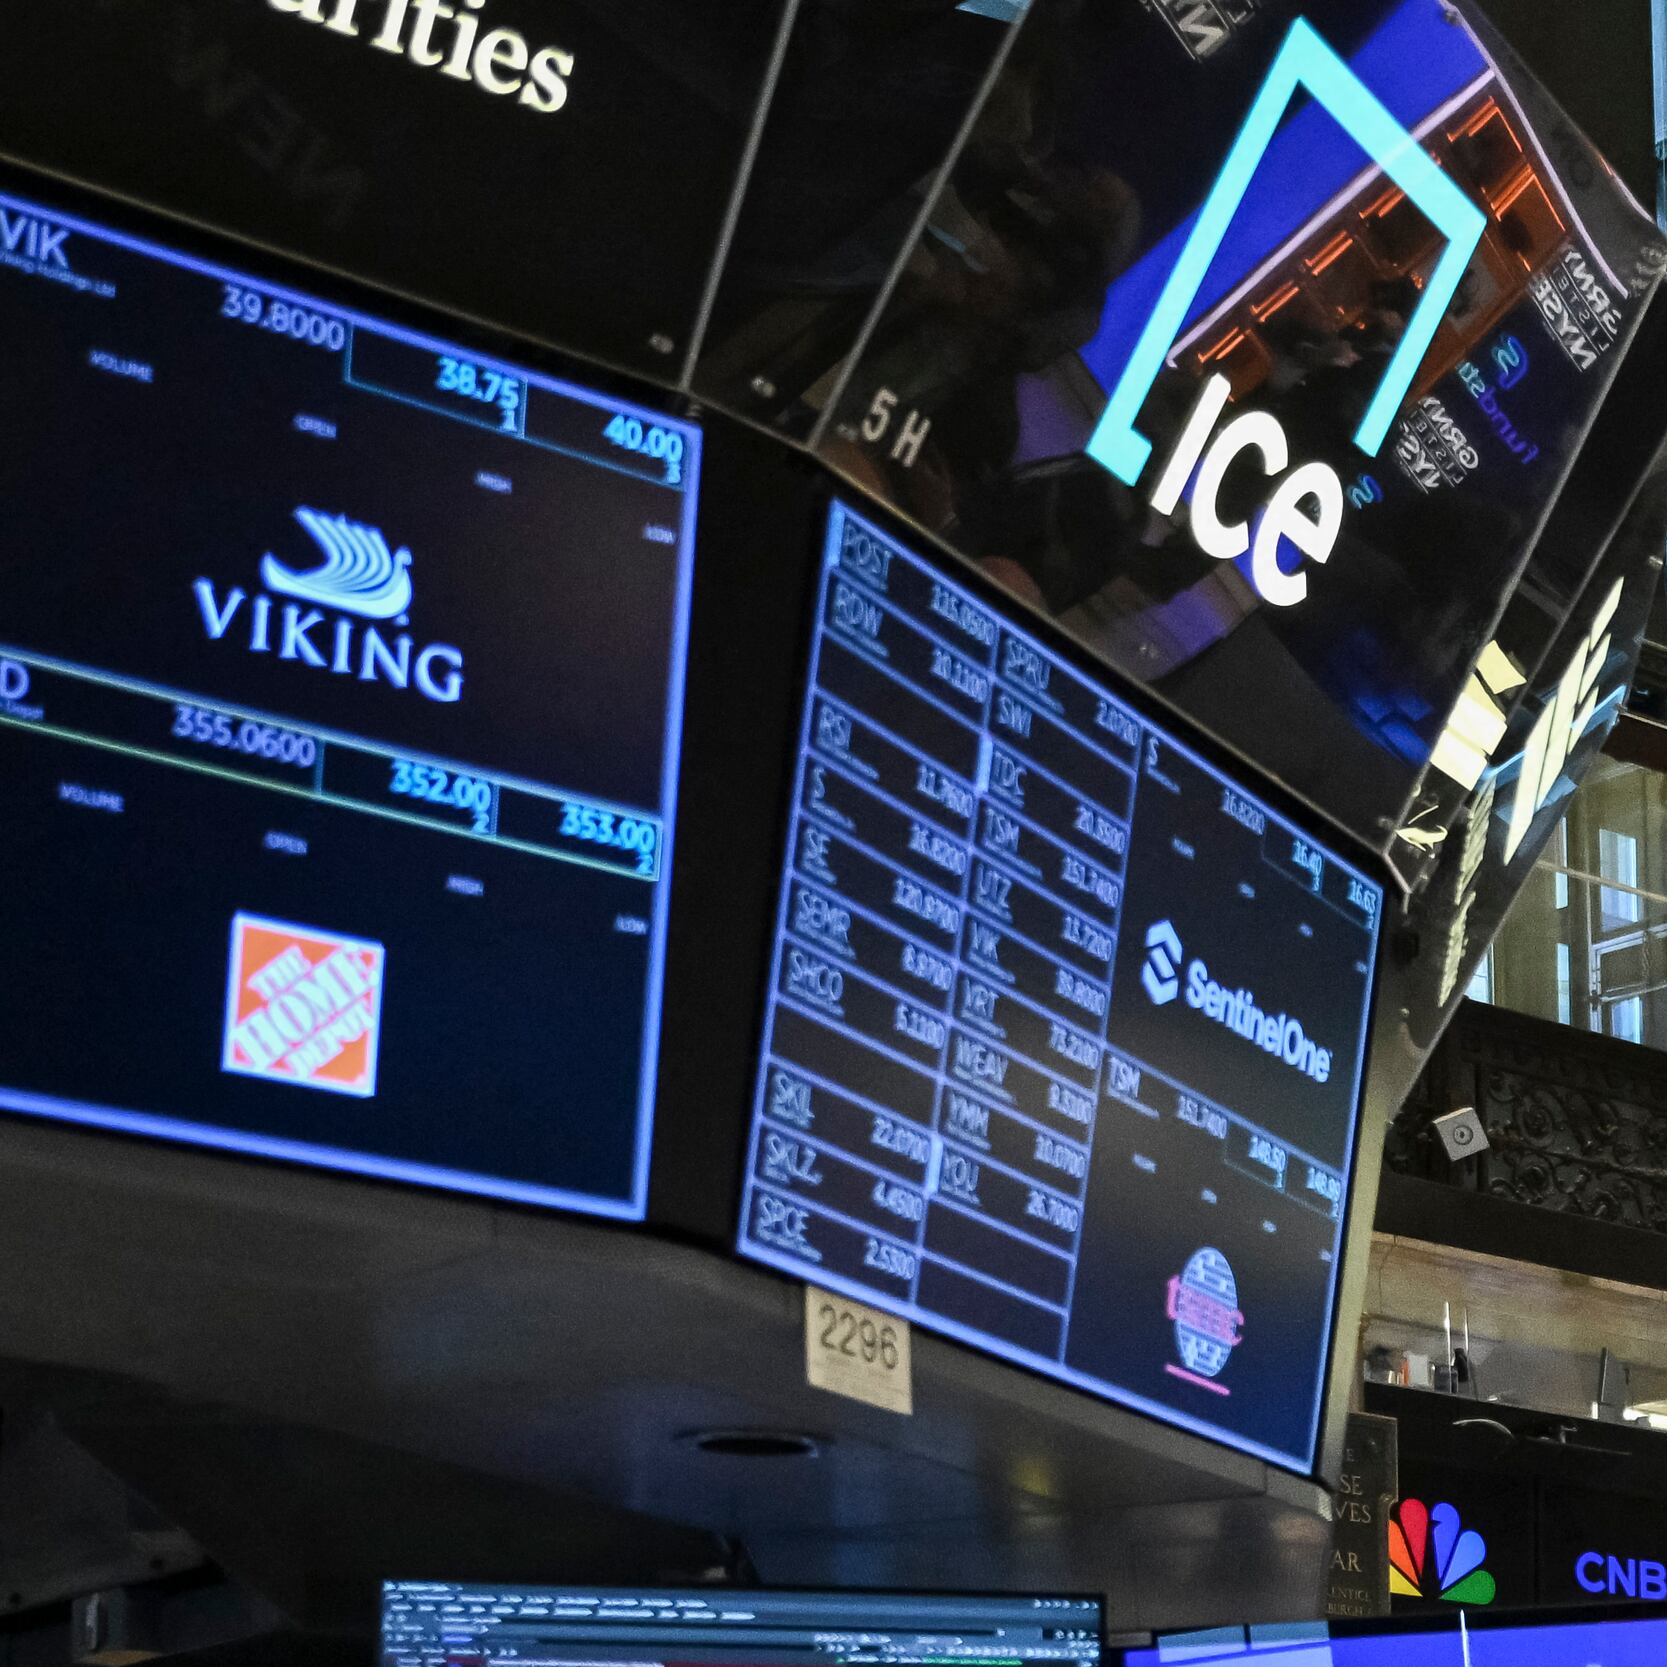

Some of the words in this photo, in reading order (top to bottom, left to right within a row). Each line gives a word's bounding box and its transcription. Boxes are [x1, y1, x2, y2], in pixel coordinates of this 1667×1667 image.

[221, 284, 346, 351] 39.8000
[436, 357, 520, 408] 38.75
[603, 419, 684, 463] 40.00
[193, 576, 464, 703] VIKING
[172, 703, 317, 768] 355.0600
[389, 758, 492, 813] 352.00
[560, 800, 656, 853] 353.00
[1185, 960, 1333, 1084] SentinelOne
[817, 1302, 899, 1370] 2296
